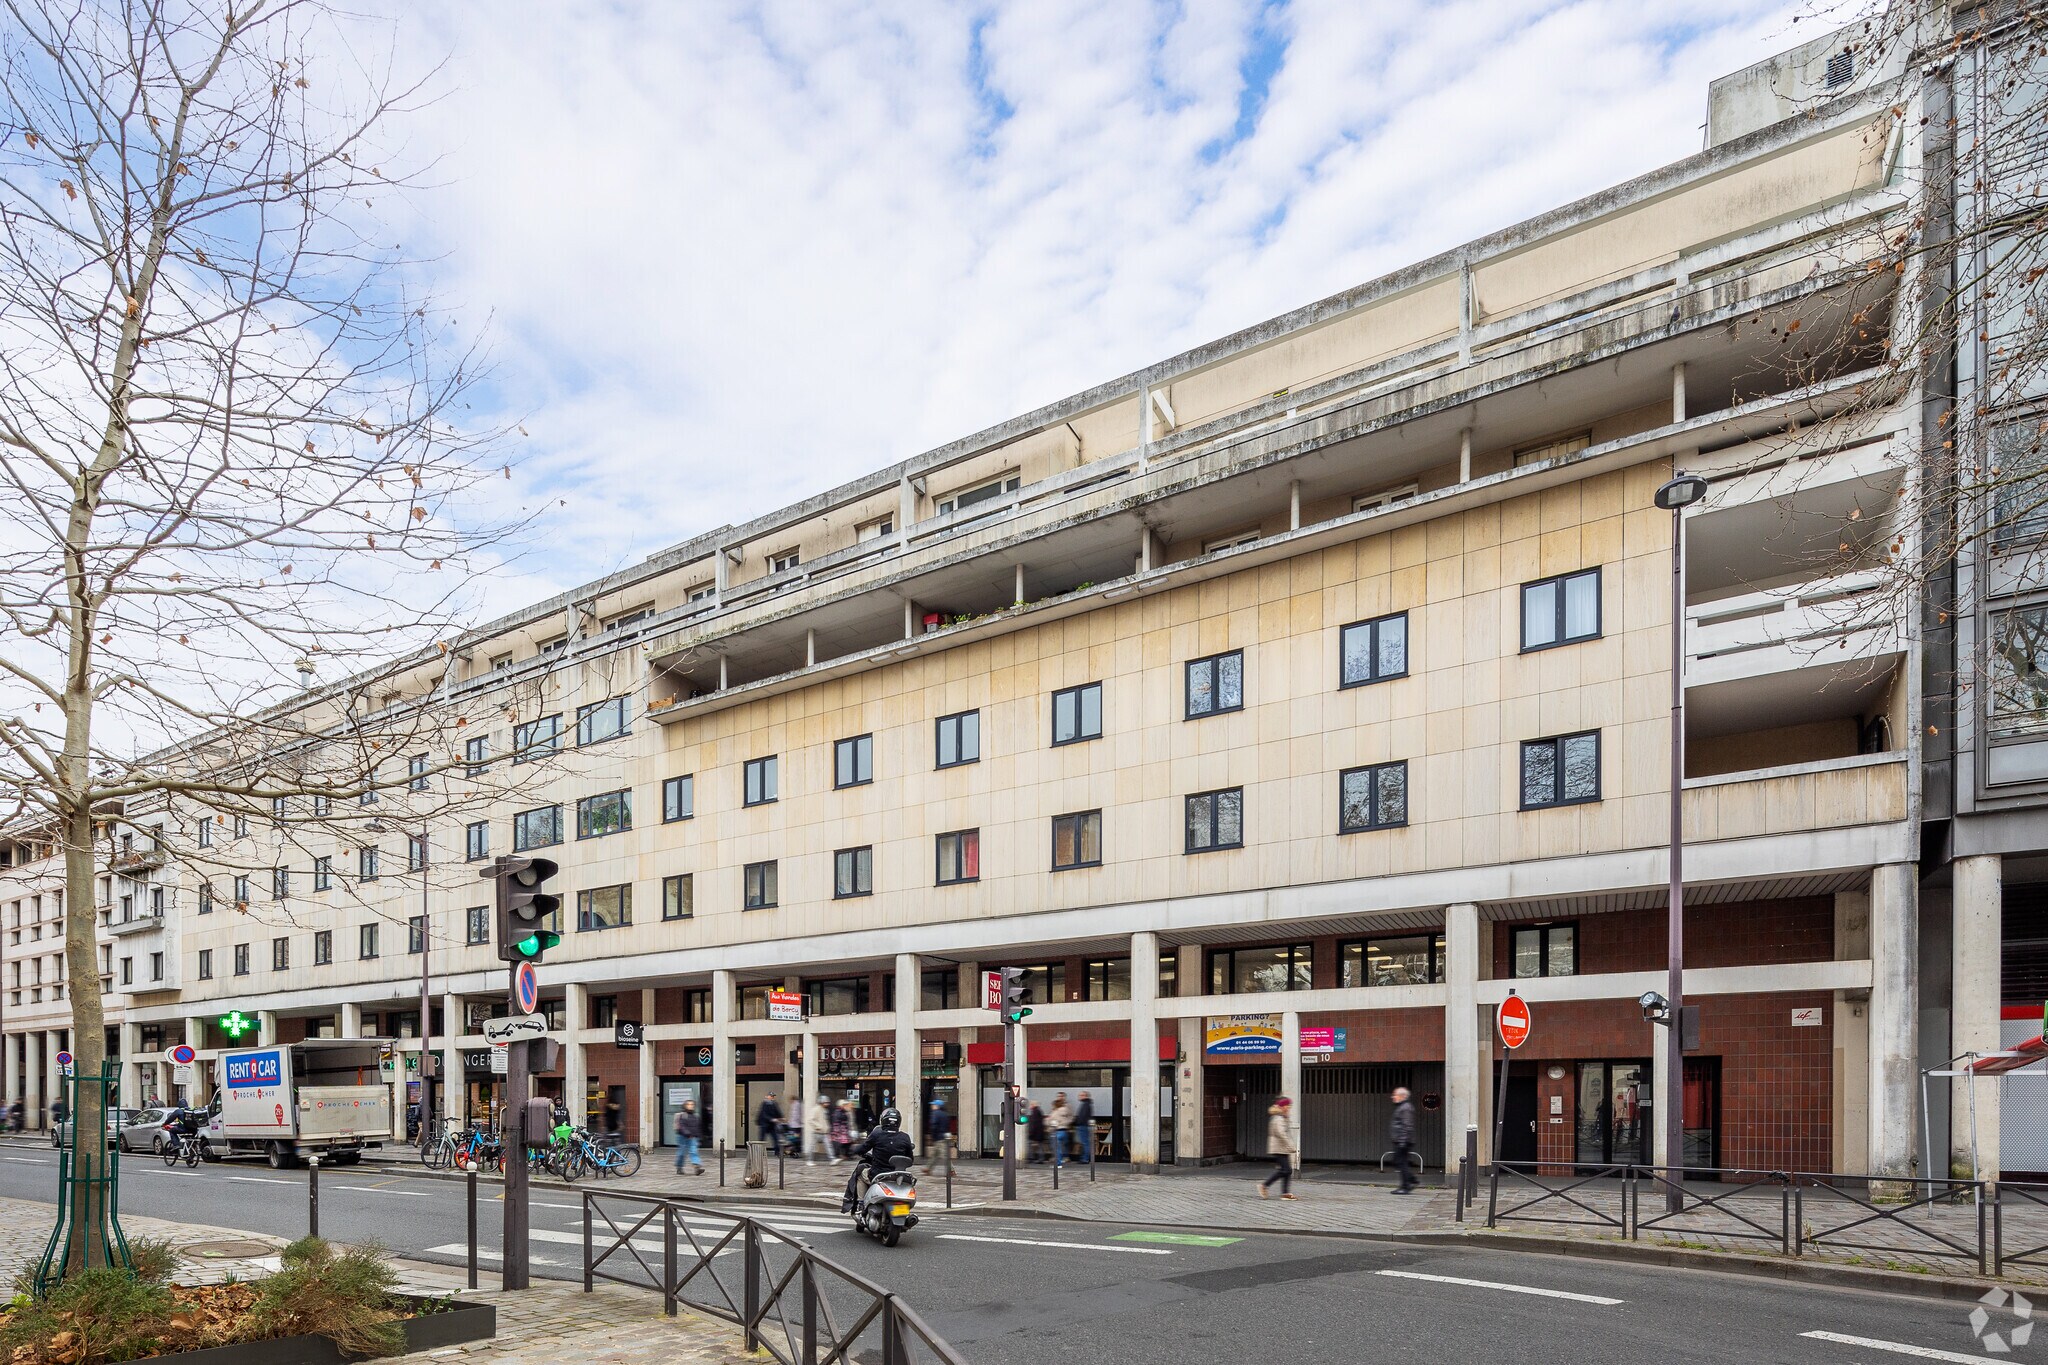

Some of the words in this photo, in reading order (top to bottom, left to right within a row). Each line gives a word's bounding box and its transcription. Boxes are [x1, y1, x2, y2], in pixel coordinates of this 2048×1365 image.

[990, 990, 1002, 1004] BO
[820, 1046, 896, 1061] BOUCHER
[1321, 1054, 1330, 1062] 10
[229, 1062, 250, 1079] RENT
[258, 1060, 277, 1077] CAR
